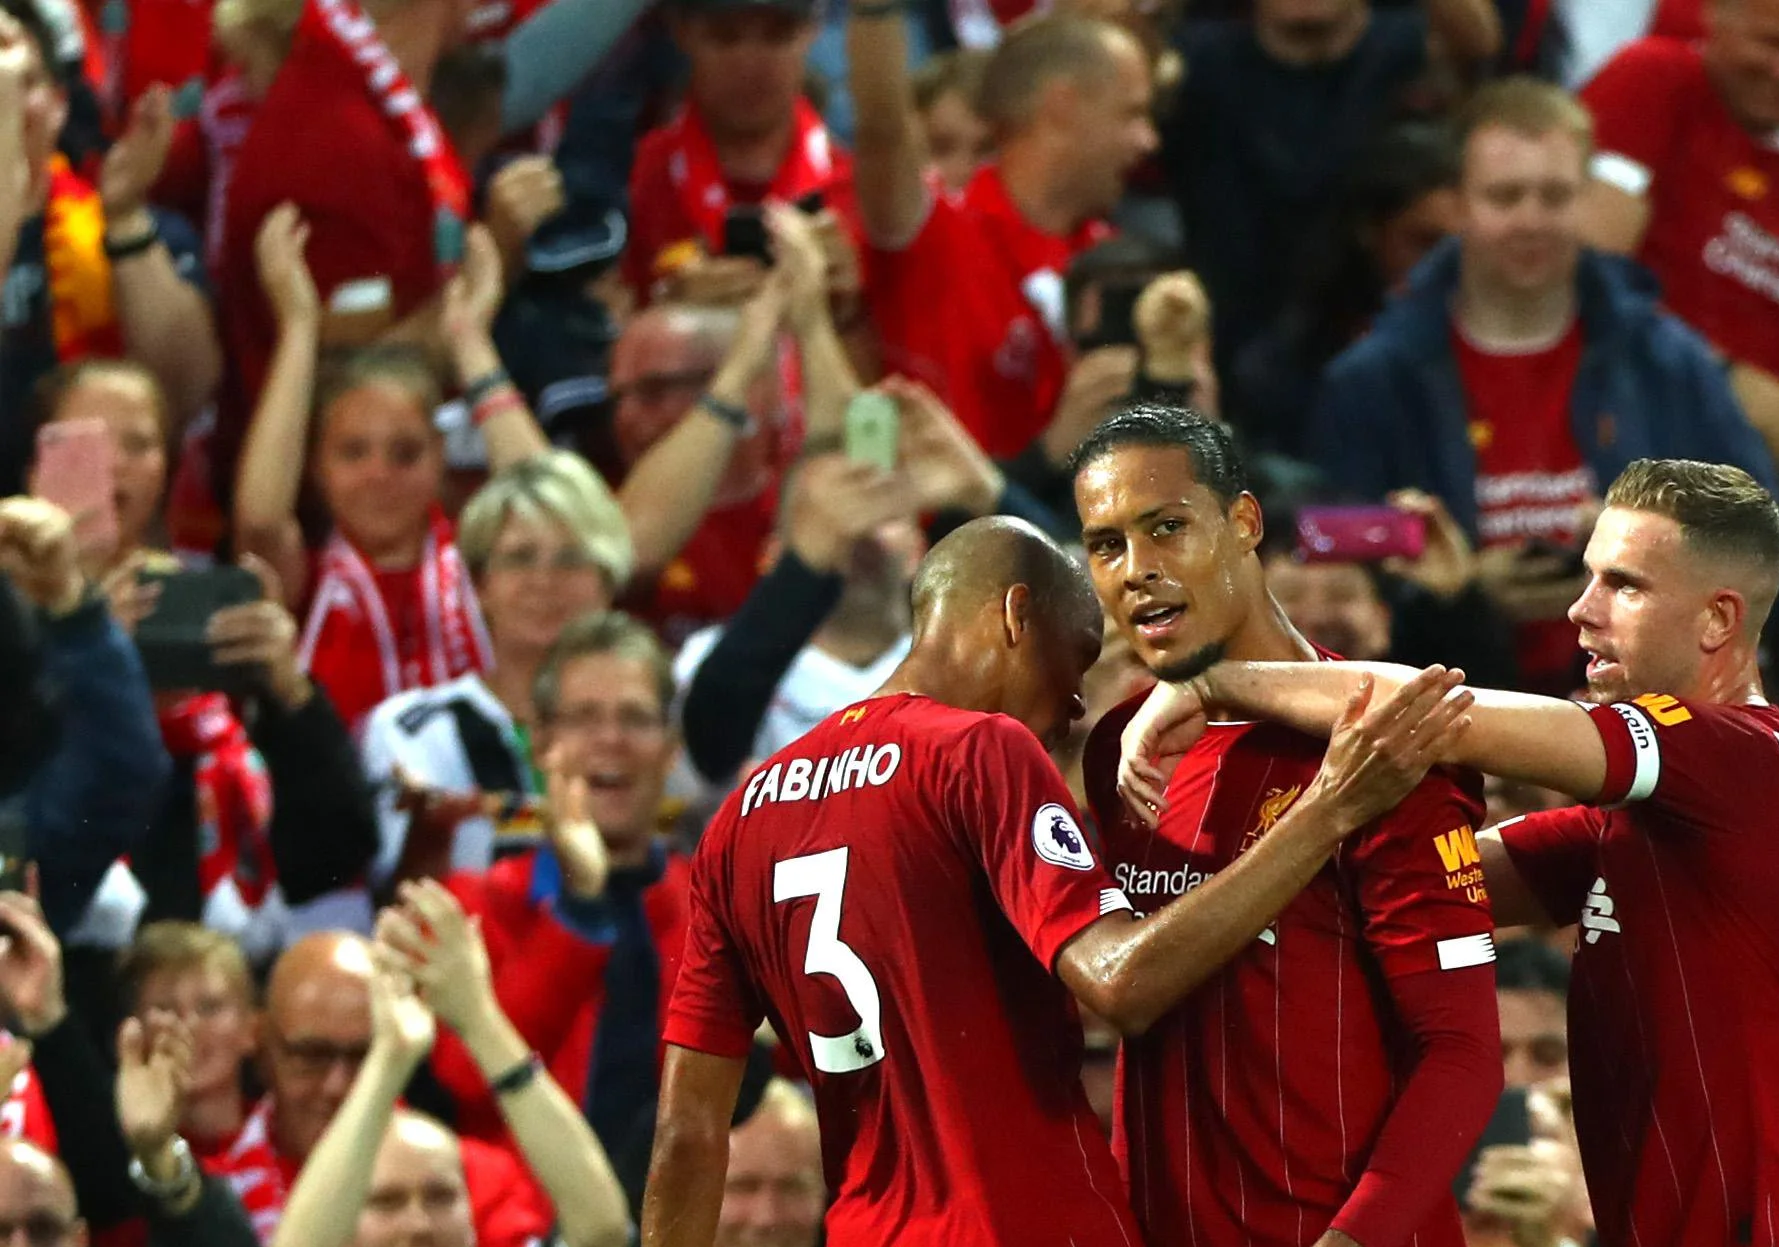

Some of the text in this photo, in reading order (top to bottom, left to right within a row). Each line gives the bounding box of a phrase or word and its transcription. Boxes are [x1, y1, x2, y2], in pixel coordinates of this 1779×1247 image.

[740, 742, 901, 817] FABINHO
[1114, 861, 1216, 895] Standar
[1445, 867, 1485, 890] Weste
[772, 845, 885, 1074] 3
